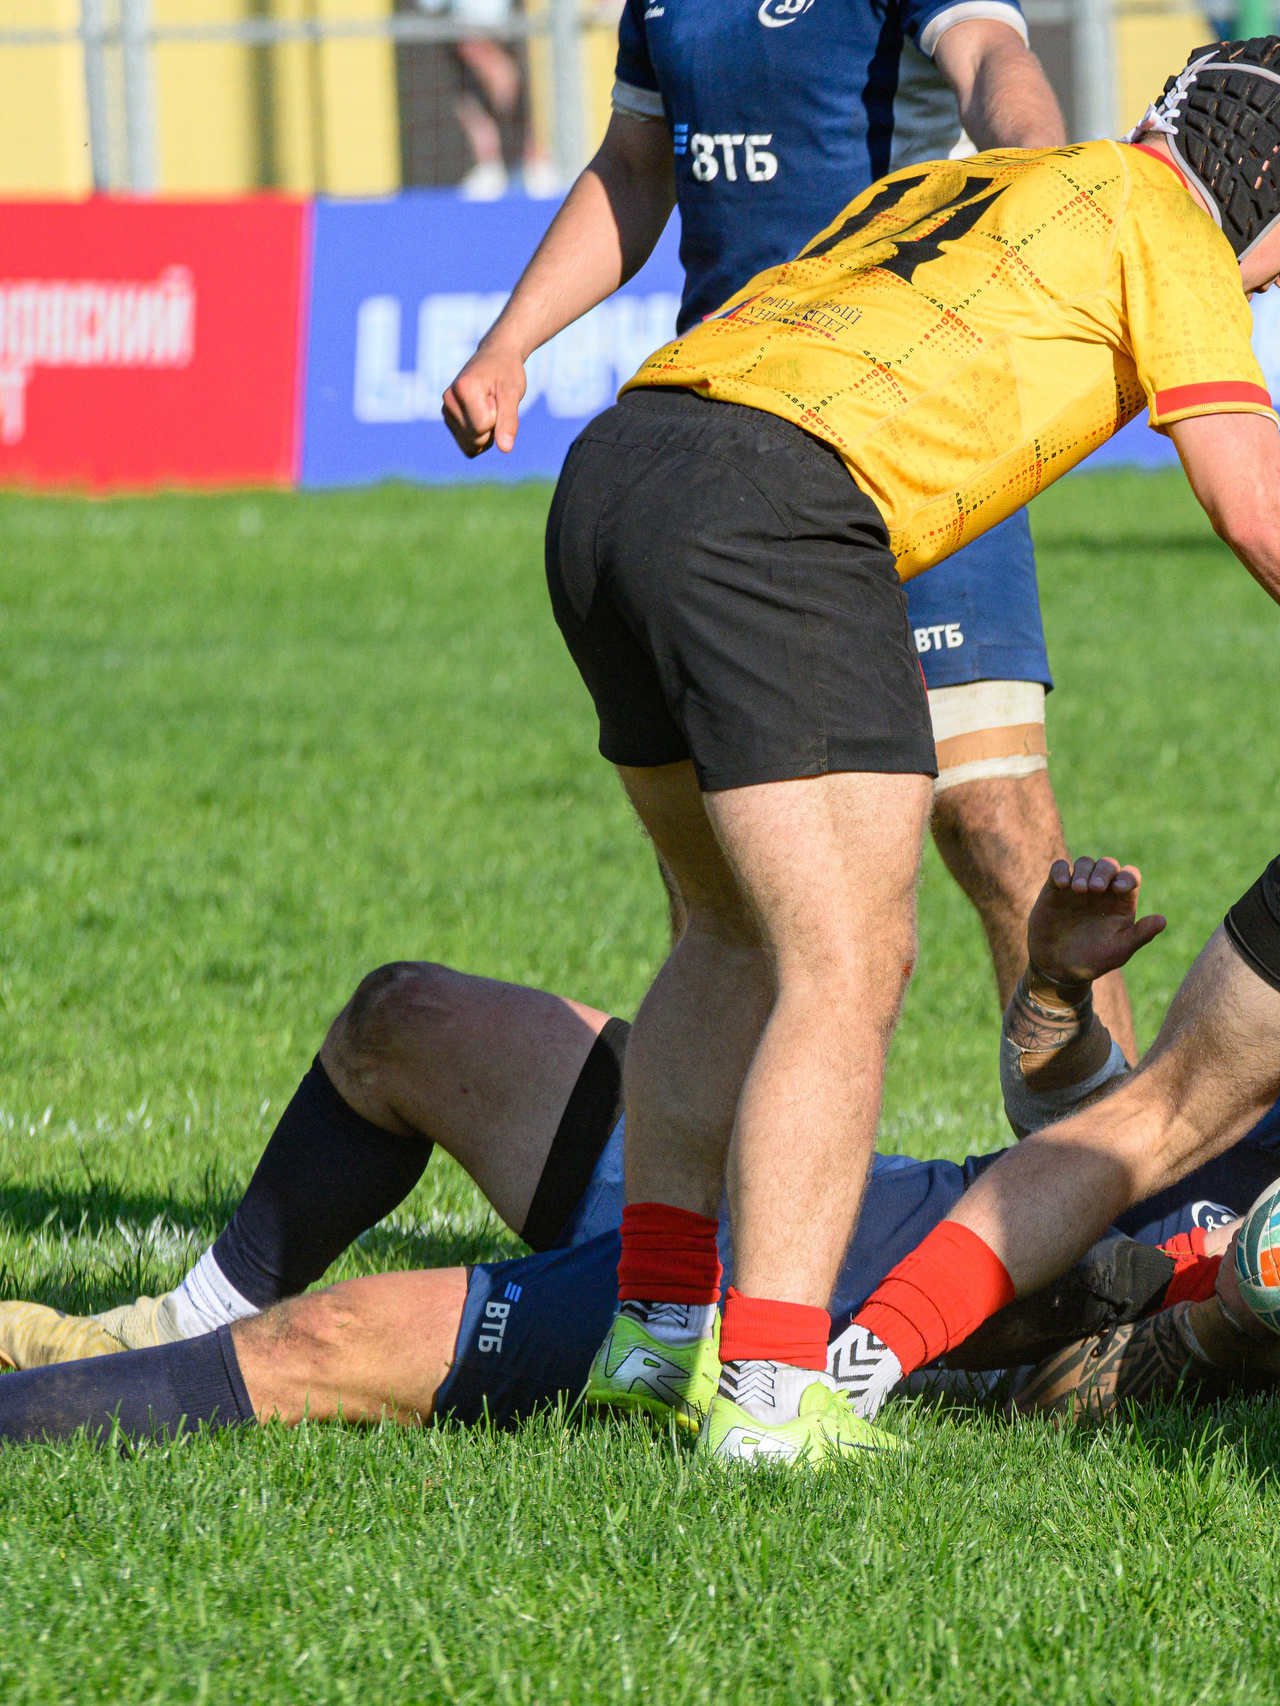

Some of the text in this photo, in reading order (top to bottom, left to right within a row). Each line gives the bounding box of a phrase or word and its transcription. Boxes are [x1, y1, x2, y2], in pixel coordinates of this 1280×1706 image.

[691, 133, 778, 182] ВТБ
[913, 623, 964, 653] ВТБ
[478, 1301, 510, 1353] ВТБ
